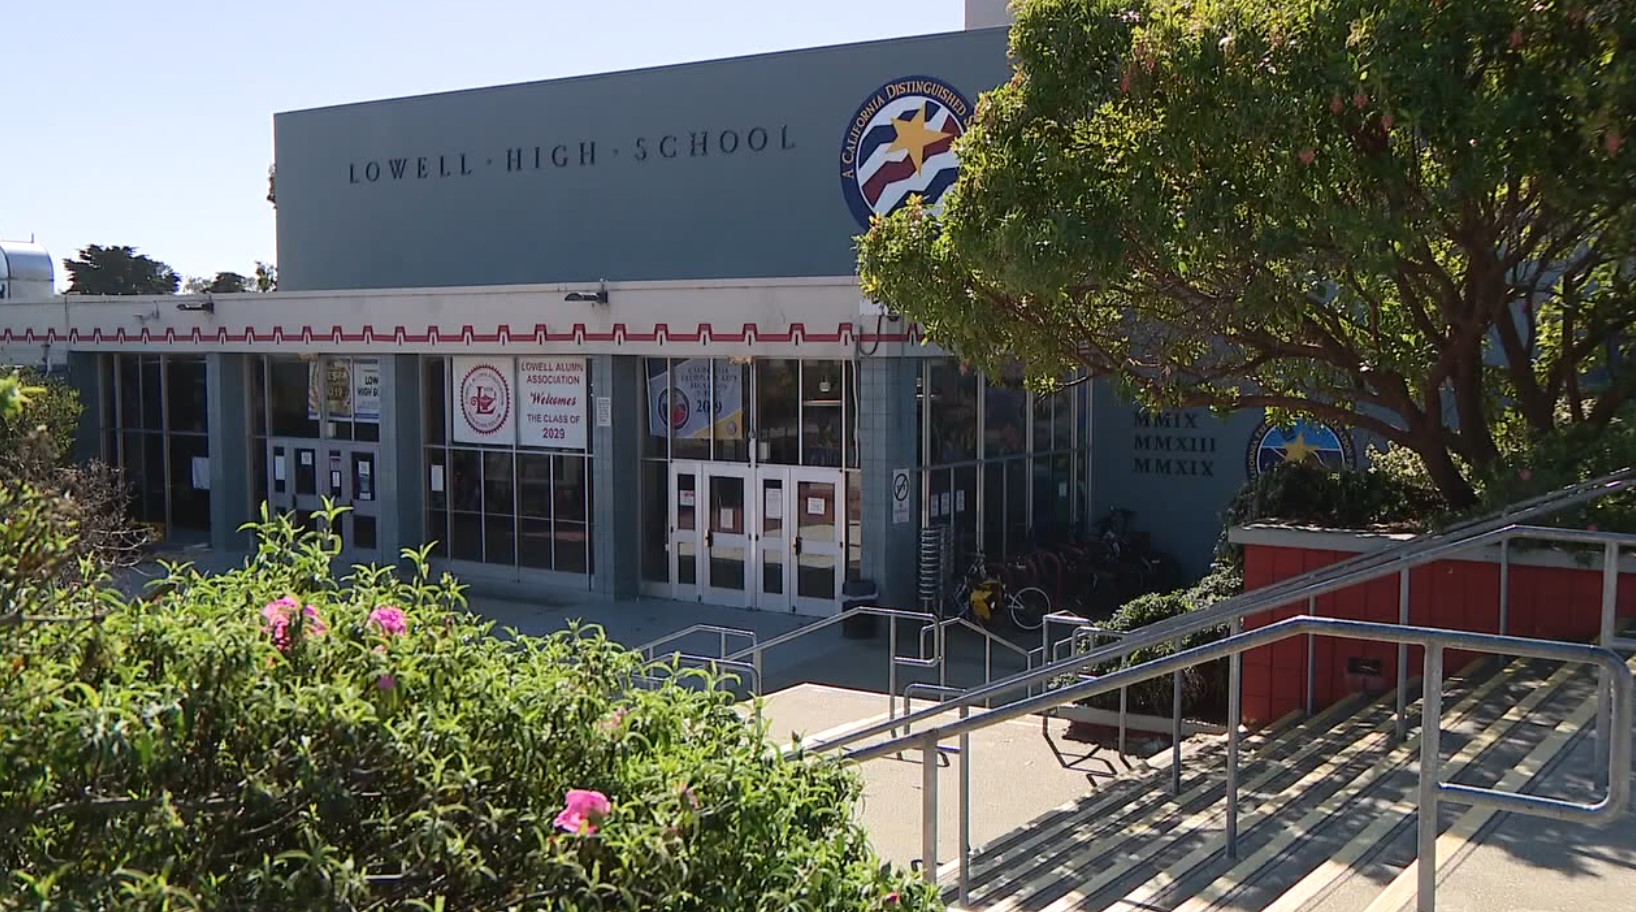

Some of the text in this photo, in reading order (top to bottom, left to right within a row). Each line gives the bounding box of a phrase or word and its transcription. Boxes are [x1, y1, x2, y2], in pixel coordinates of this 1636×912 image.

[842, 80, 967, 179] A CALIFORNIA DISTINGUISHED
[349, 124, 797, 184] LOWELL HIGH SCHOOL
[521, 362, 553, 372] LOWELL
[365, 376, 379, 385] LOW
[526, 374, 580, 385] ASSOCIATION
[530, 391, 577, 406] Welcomes
[527, 413, 581, 424] THE CLASS OF
[1134, 410, 1199, 428] MMIX
[543, 427, 565, 439] 2029
[1134, 434, 1216, 453] MMXIII
[1134, 458, 1215, 477] MMXIX
